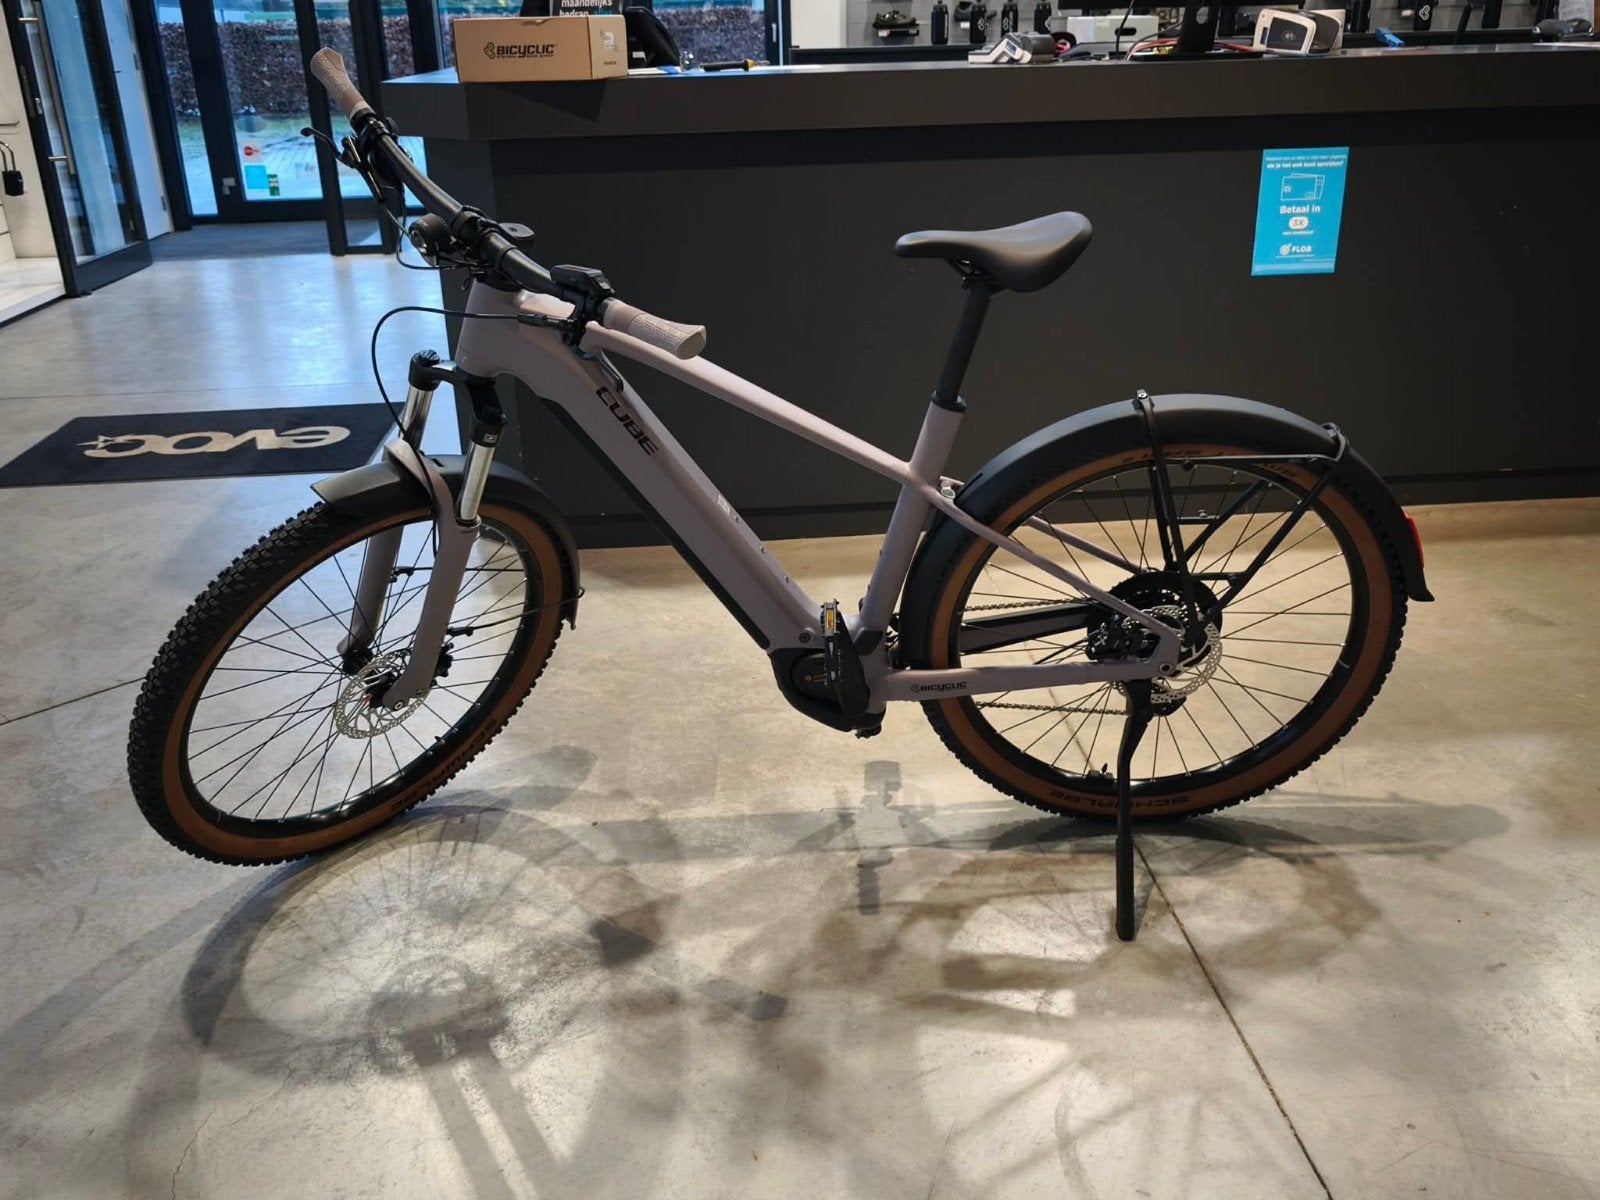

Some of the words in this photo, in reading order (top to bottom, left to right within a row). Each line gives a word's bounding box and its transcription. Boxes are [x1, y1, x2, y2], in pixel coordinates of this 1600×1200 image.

[497, 44, 554, 58] BICYCLIC
[1280, 204, 1310, 214] Betaal
[1311, 204, 1321, 213] in
[596, 386, 659, 456] CUBE
